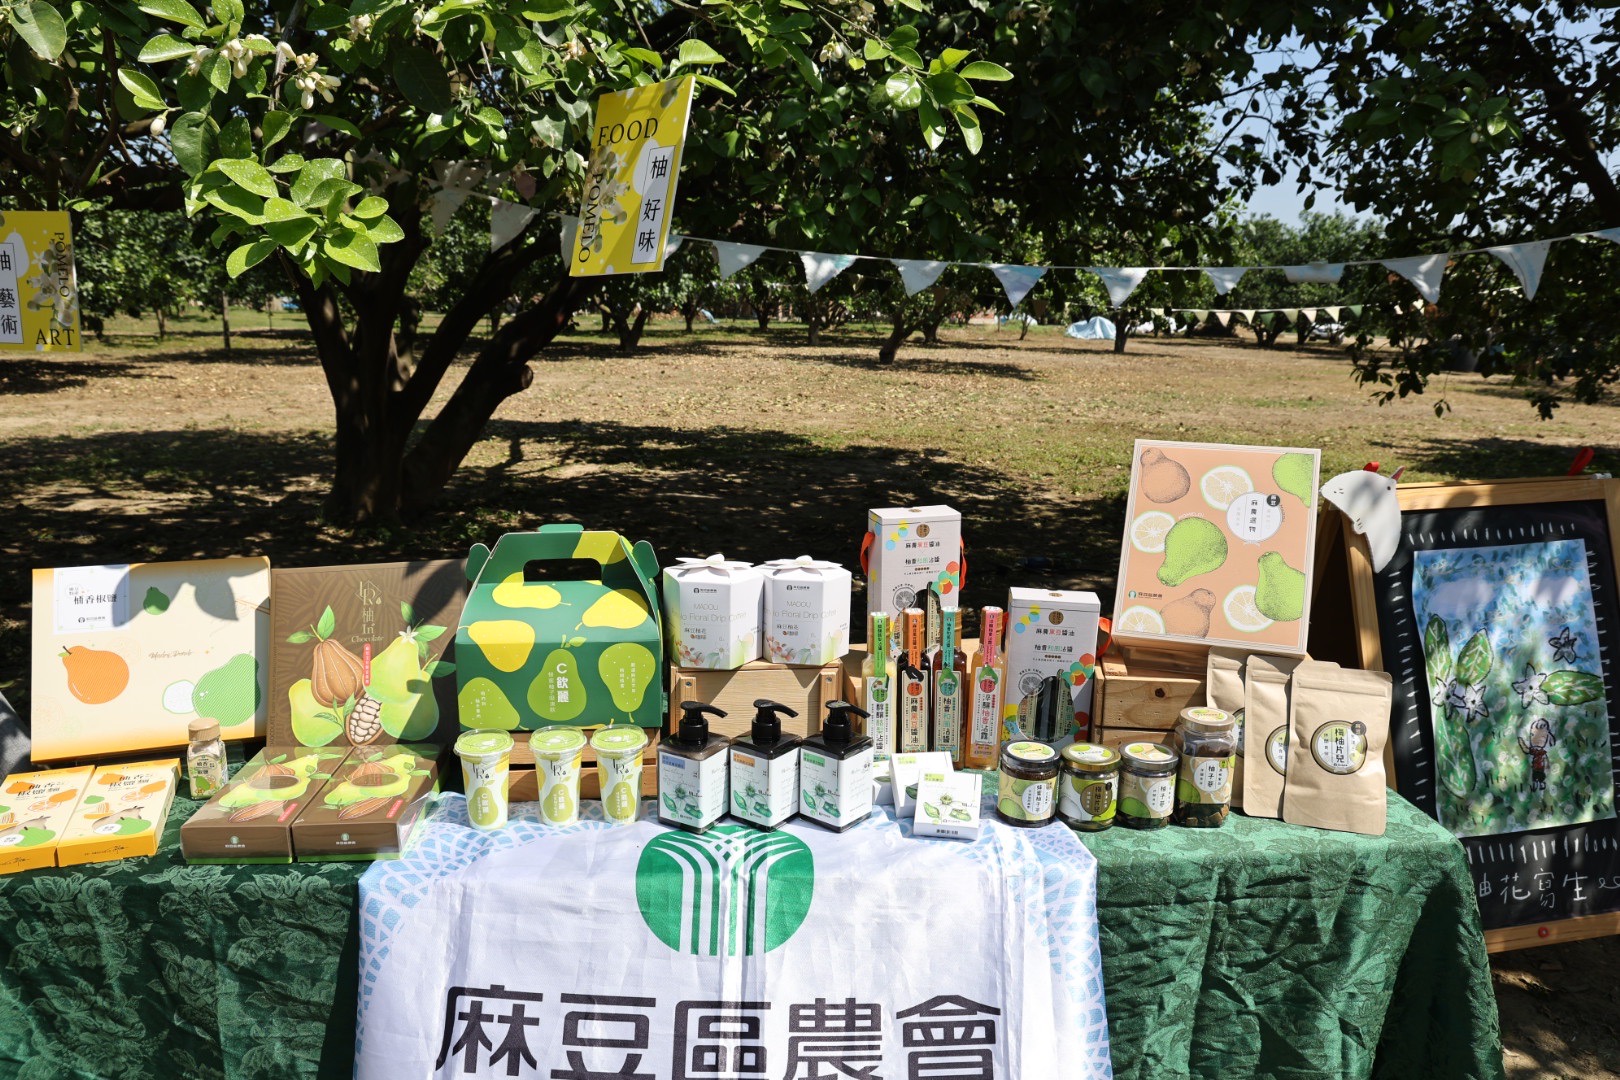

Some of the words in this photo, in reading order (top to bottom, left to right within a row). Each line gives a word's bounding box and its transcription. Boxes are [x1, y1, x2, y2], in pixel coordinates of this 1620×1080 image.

[597, 118, 659, 147] FOOD
[578, 173, 604, 263] POMELO
[638, 156, 668, 252] 柚好味
[54, 232, 70, 298] POMELO
[36, 328, 75, 346] ART
[1335, 728, 1345, 763] 梅柚片兒
[435, 984, 1001, 1080] 麻豆區農會
